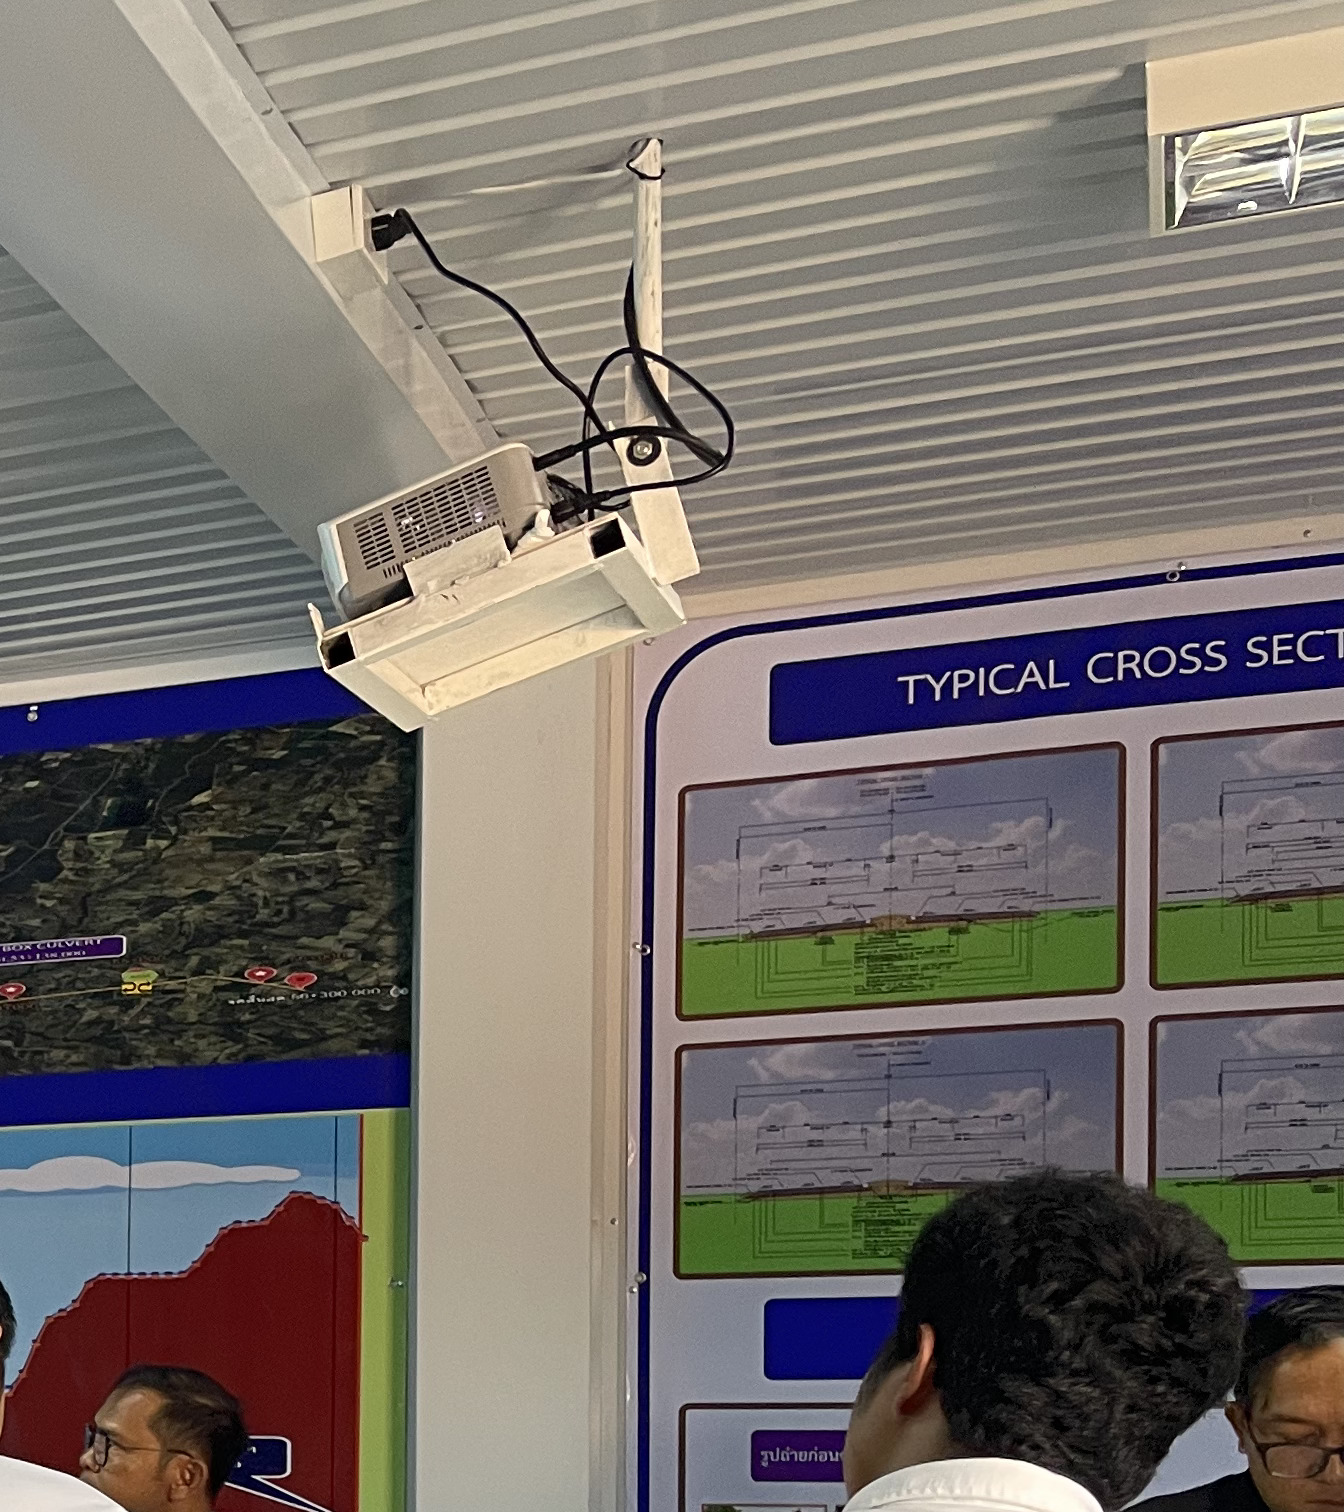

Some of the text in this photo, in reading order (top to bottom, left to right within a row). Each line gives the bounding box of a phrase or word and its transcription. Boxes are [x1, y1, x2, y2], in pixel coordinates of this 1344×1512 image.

[898, 628, 1344, 706] TYPICAL CROSS SECT
